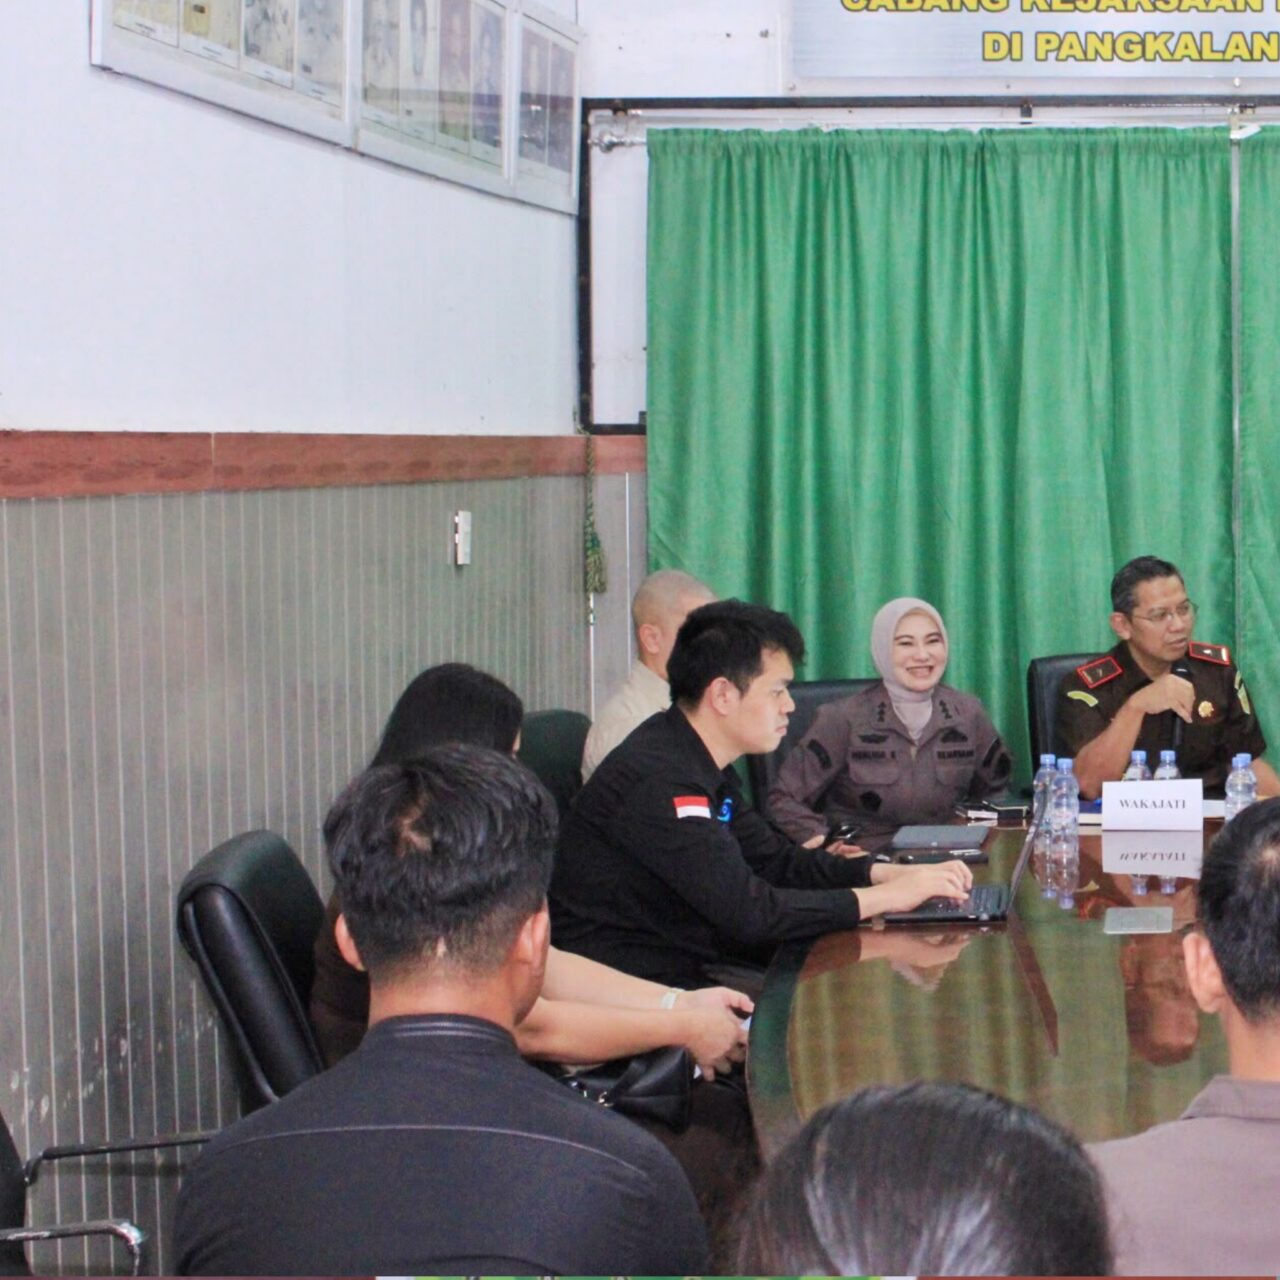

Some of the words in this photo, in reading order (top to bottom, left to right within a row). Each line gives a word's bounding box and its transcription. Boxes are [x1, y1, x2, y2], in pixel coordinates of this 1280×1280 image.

[982, 32, 1022, 62] DI
[1035, 32, 1280, 62] PANGKALAN
[1119, 799, 1187, 809] WAKAJATI
